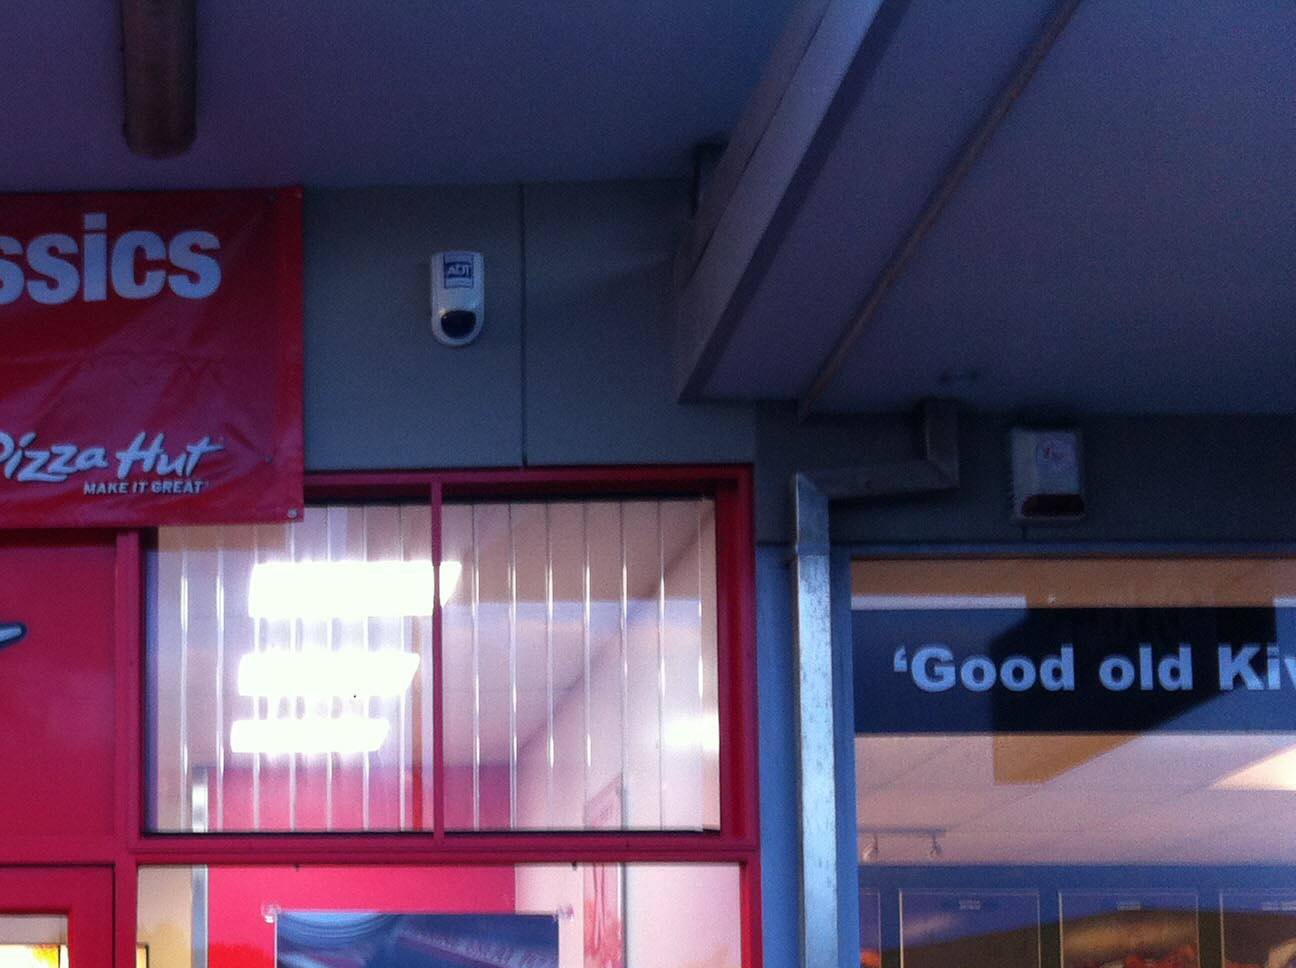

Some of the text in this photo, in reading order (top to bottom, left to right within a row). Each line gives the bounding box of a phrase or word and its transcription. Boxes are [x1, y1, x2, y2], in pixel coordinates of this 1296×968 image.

[116, 432, 224, 480] Hut
[84, 481, 127, 495] MAKE
[132, 481, 147, 493] IT
[1099, 643, 1194, 691] old
